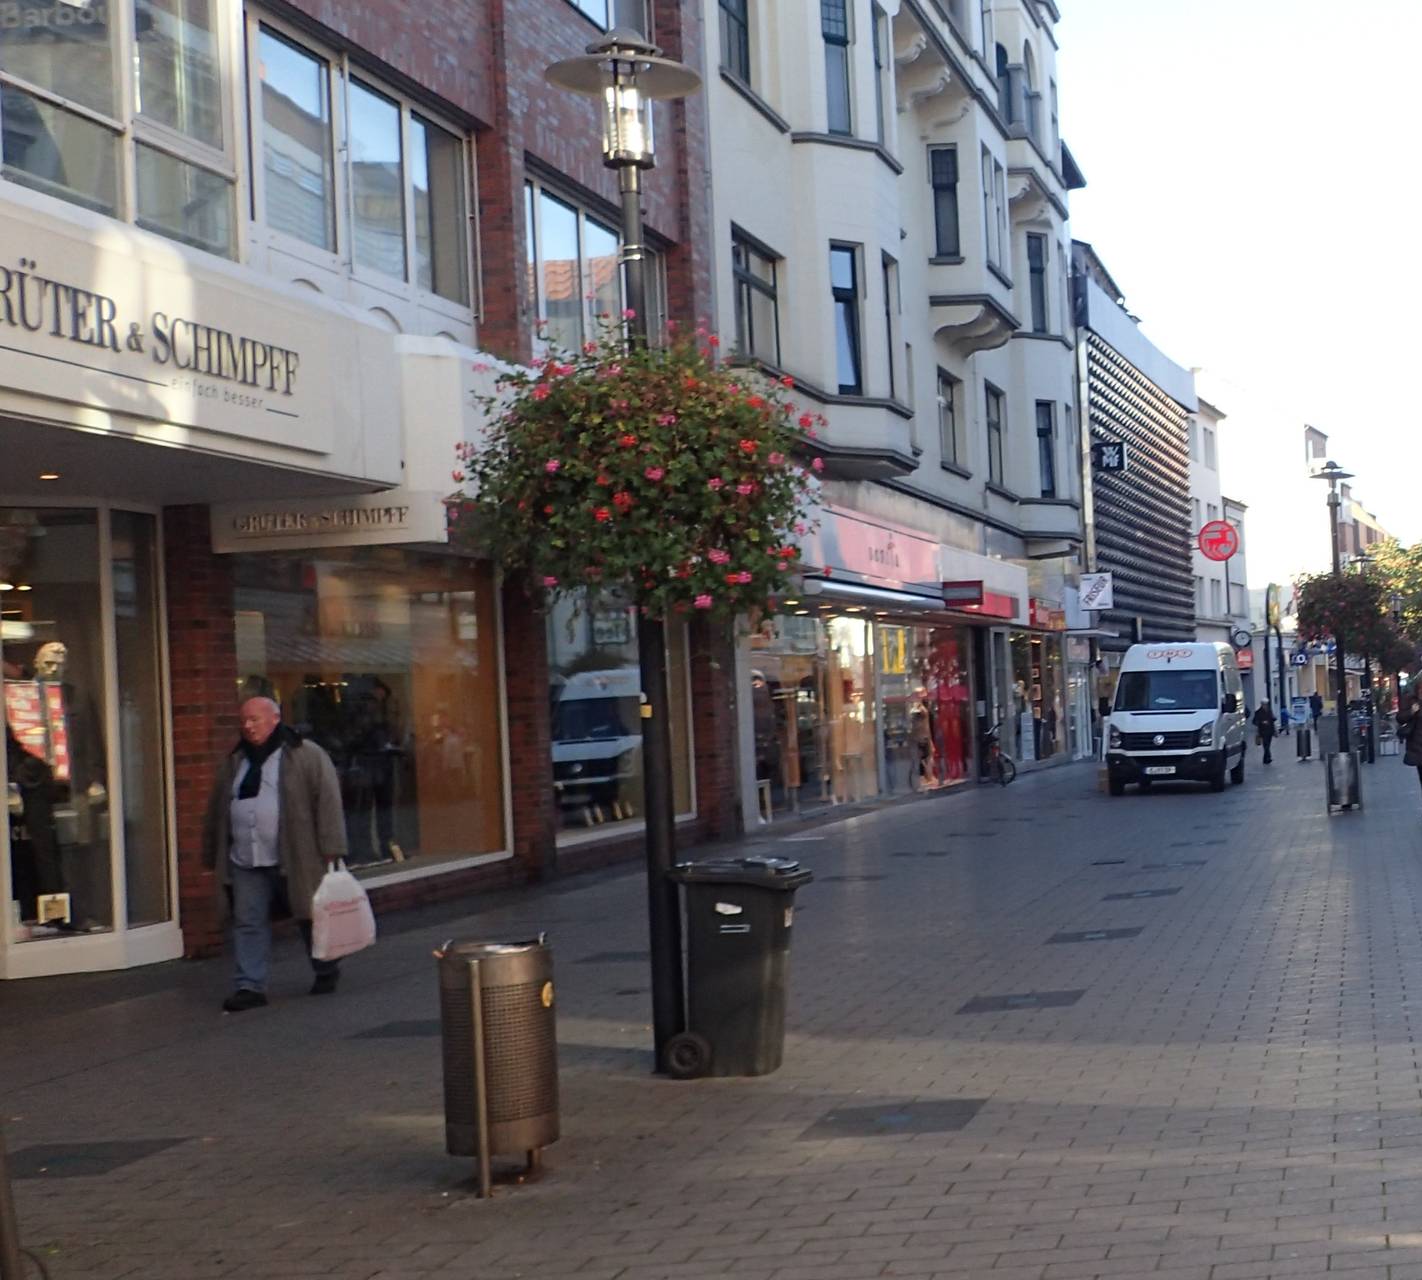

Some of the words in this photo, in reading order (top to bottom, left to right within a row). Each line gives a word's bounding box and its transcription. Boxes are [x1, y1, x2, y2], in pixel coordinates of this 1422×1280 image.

[125, 321, 145, 353] &
[151, 311, 299, 396] SCHIMPFF
[223, 389, 264, 408] besser
